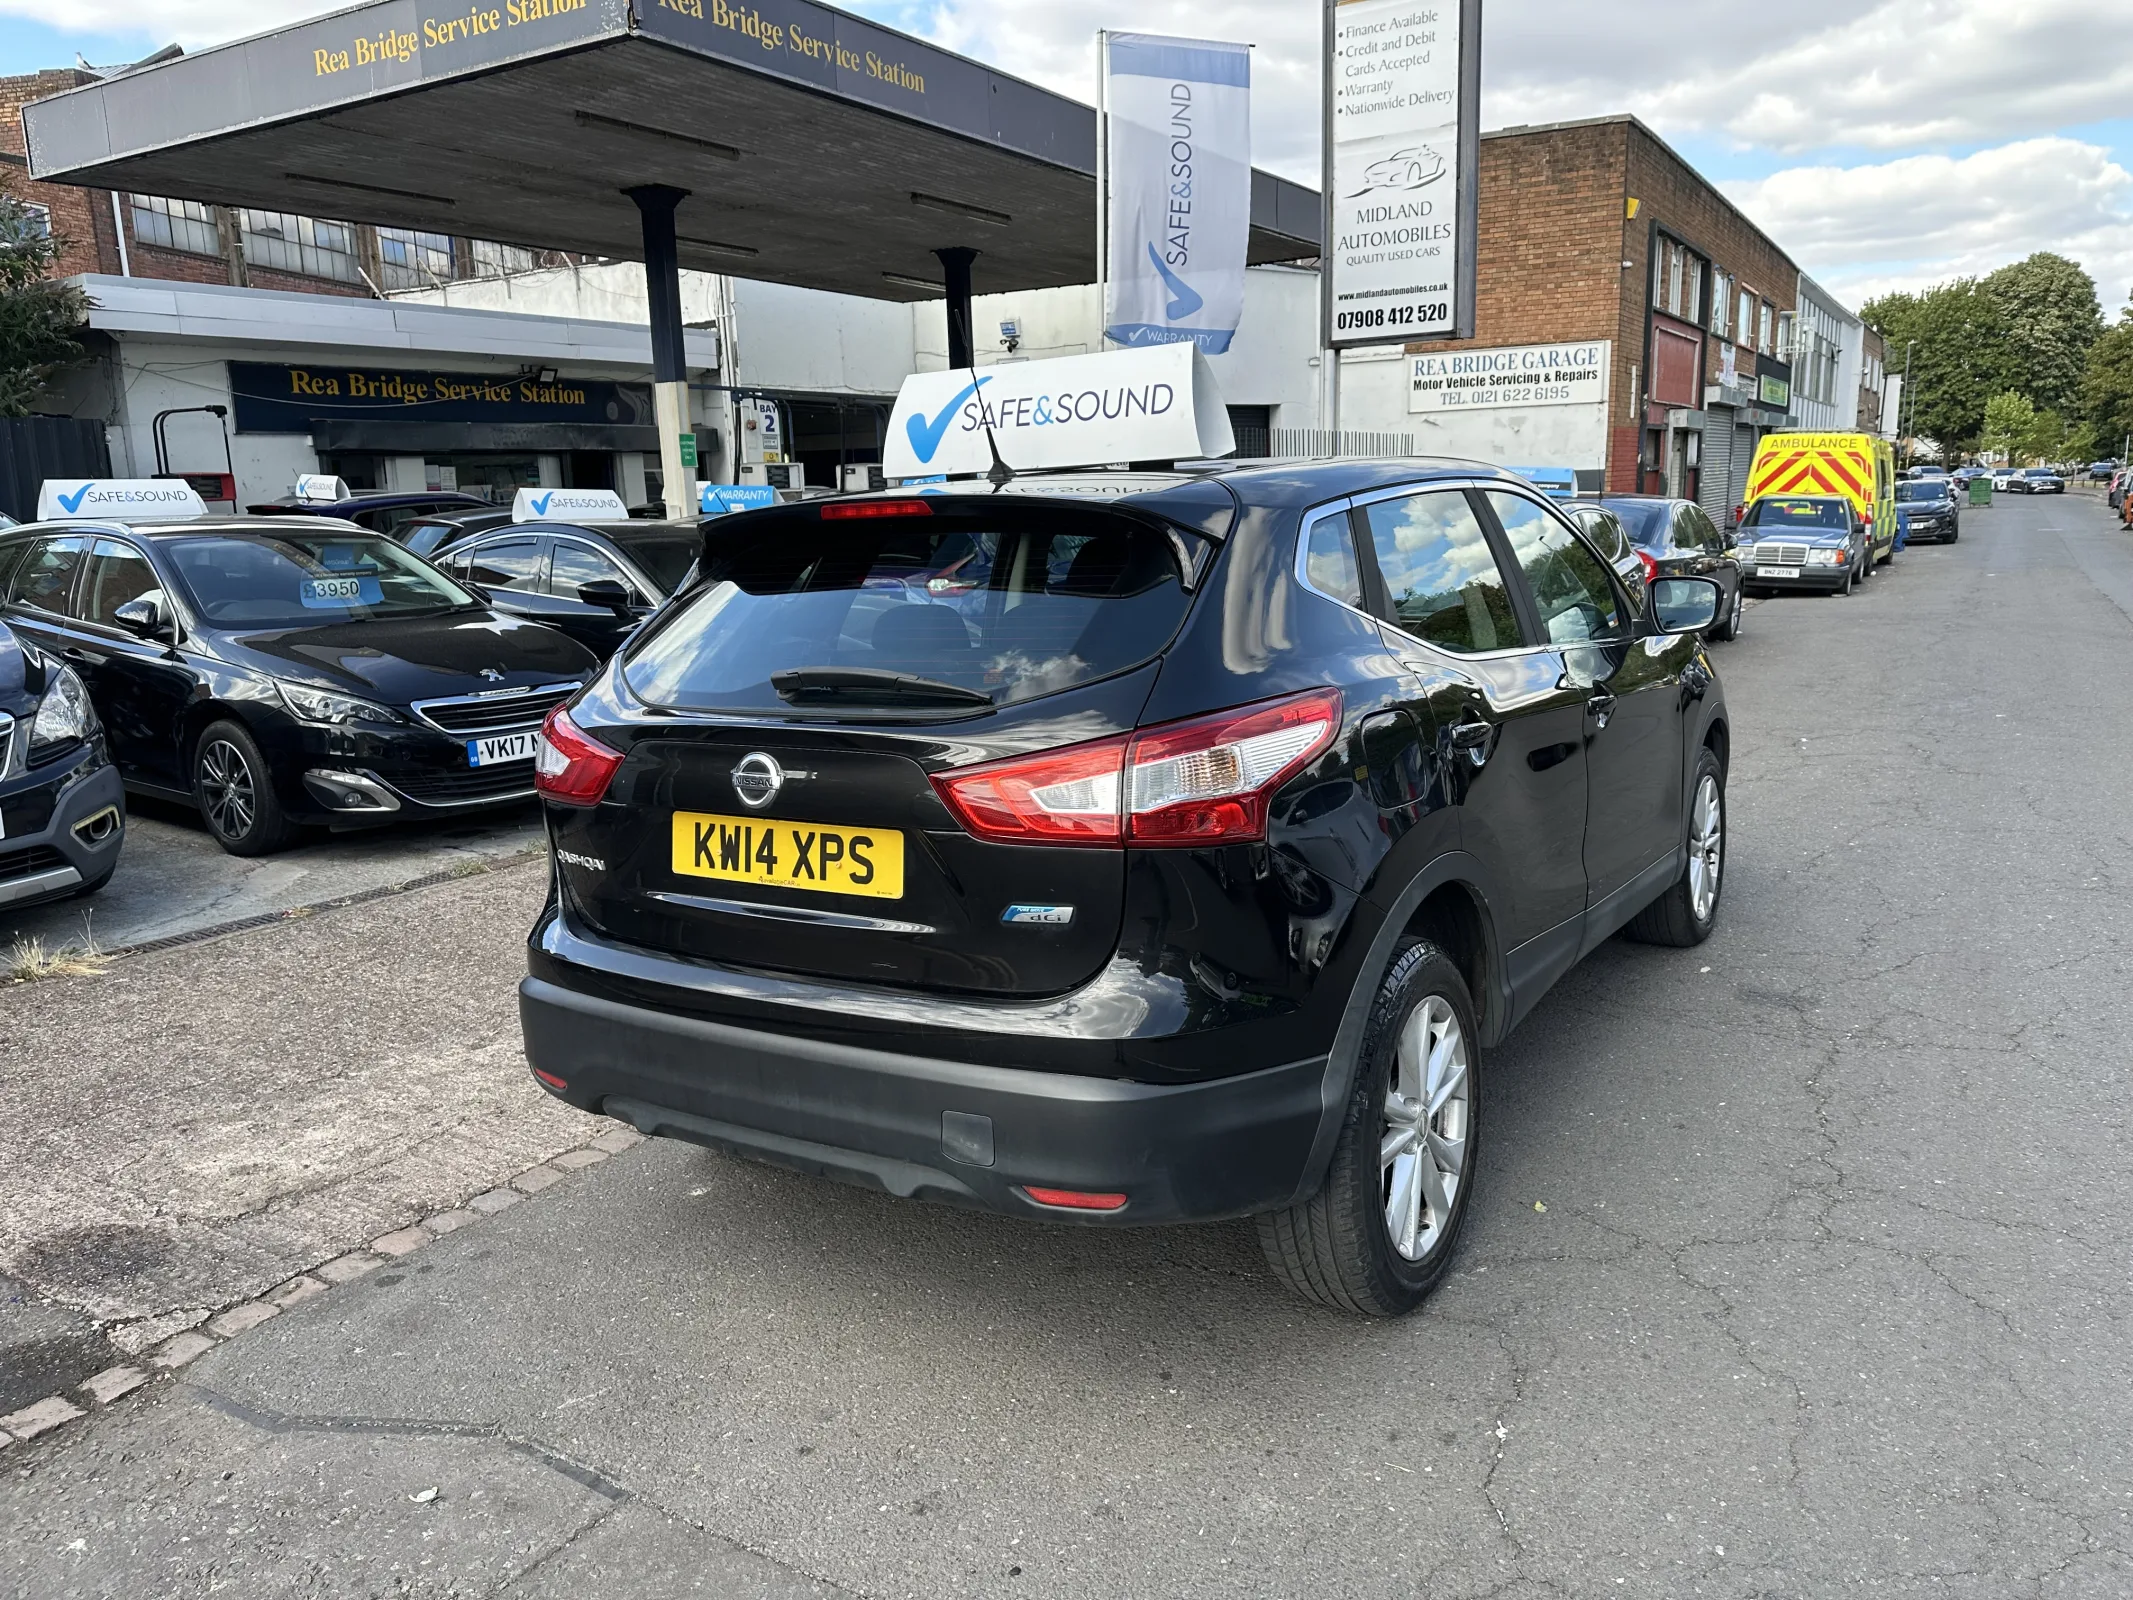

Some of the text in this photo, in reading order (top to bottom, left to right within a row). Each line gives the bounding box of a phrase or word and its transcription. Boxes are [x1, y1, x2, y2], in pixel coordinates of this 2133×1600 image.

[1346, 10, 1438, 39] Finance Available
[313, 48, 350, 76] Rea
[354, 29, 419, 63] Bridge
[423, 6, 500, 48] Service
[712, 0, 784, 50] Bridge
[789, 23, 860, 72] Service
[865, 50, 925, 94] Station
[1346, 31, 1436, 58] Credit and Debit
[1345, 50, 1430, 77] Cards Accepted
[1345, 80, 1393, 97] Warranty
[1345, 90, 1454, 116] Nationwide Delivery
[1166, 83, 1192, 266] SAFE&SOUND
[1356, 200, 1433, 225] MIDLAND
[1337, 223, 1451, 251] AUTOMOBILES
[1346, 246, 1441, 267] QUALITY USED CARS
[1337, 282, 1448, 301] www.midlandautomobiles.co.uk
[1337, 303, 1448, 330] 07908 412 520
[1414, 347, 1599, 377] REA BRIDGE GARAGE
[289, 370, 586, 404] Rea Bridge Service Station
[1413, 369, 1598, 391] Motor Vehicle Servicing & Repairs
[961, 383, 1174, 432] SAFE&SOUND
[1440, 385, 1569, 406] TEL. 0121 622 6195
[760, 404, 776, 414] BAY
[764, 414, 776, 433] 2
[1770, 438, 1858, 449] AMBULANCE
[87, 490, 188, 503] SAFE&SOUND
[550, 498, 618, 509] SAFE&SOUND
[720, 489, 769, 501] WARRANTY
[303, 581, 359, 600] £3950
[484, 735, 525, 760] VK17
[735, 775, 773, 788] NISSAN
[557, 848, 607, 871] QASHQAI
[694, 821, 875, 885] KW14 XPS
[1030, 914, 1062, 922] dCi
